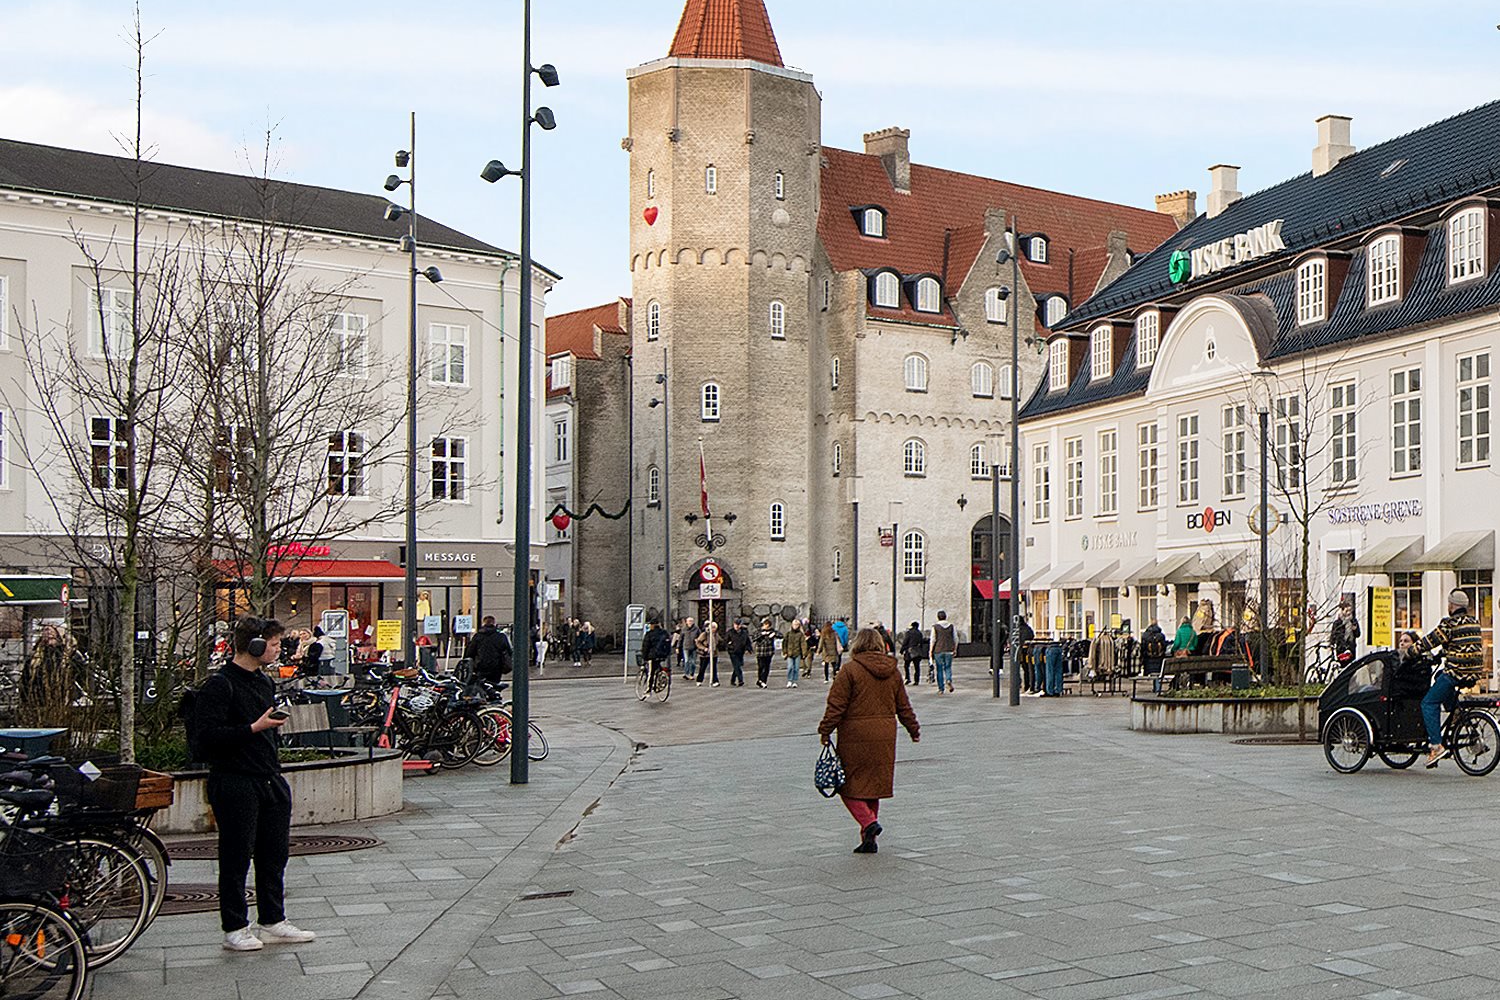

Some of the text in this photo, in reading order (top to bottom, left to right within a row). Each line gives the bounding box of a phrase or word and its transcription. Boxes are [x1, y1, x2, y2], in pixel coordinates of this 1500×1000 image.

[1188, 218, 1287, 281] JYSKE BANK
[1187, 509, 1232, 530] BOXEN
[424, 553, 477, 562] MESSAGE
